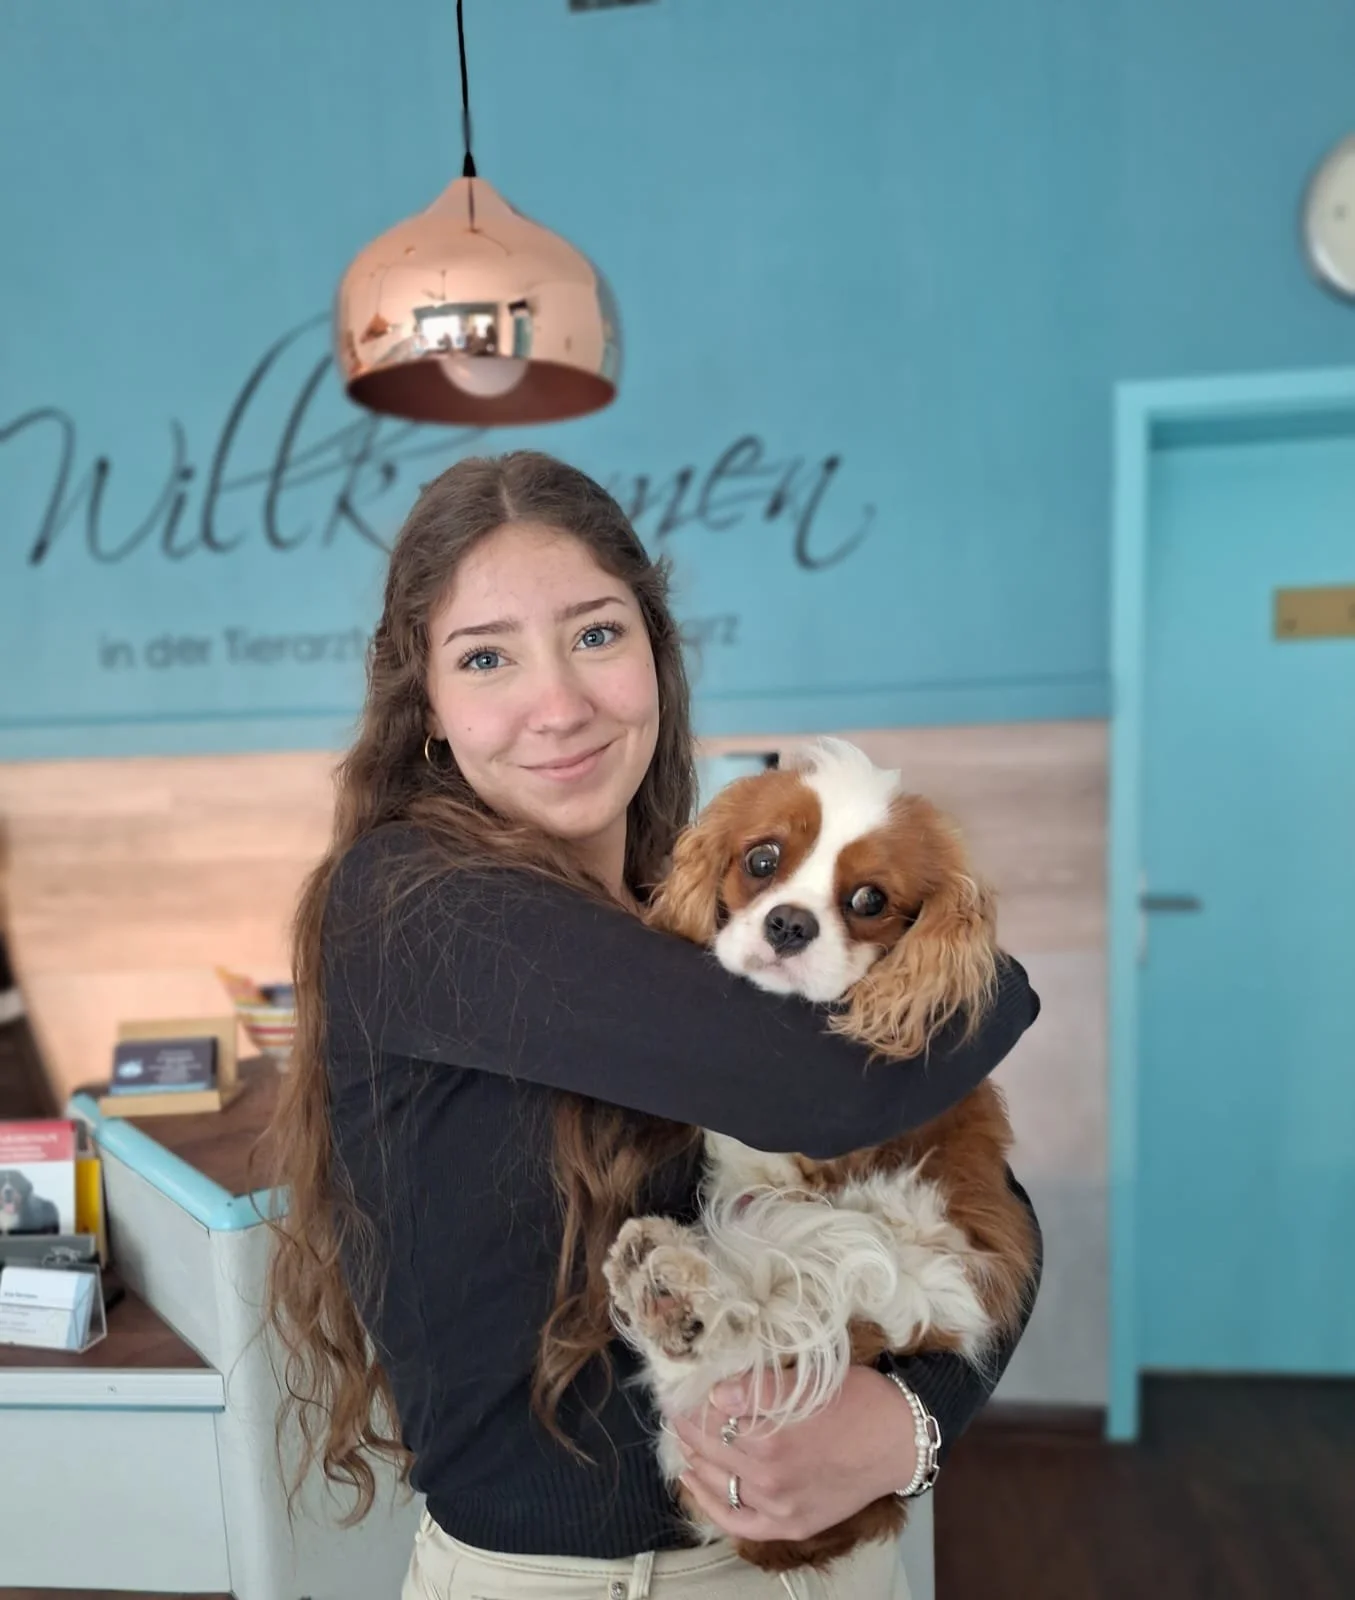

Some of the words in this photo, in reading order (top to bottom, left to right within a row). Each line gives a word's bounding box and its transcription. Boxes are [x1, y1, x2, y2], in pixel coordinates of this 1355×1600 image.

[0, 312, 877, 572] Willkmen
[98, 629, 134, 669] in
[145, 631, 211, 668] der
[223, 625, 366, 666] Tierarzt
